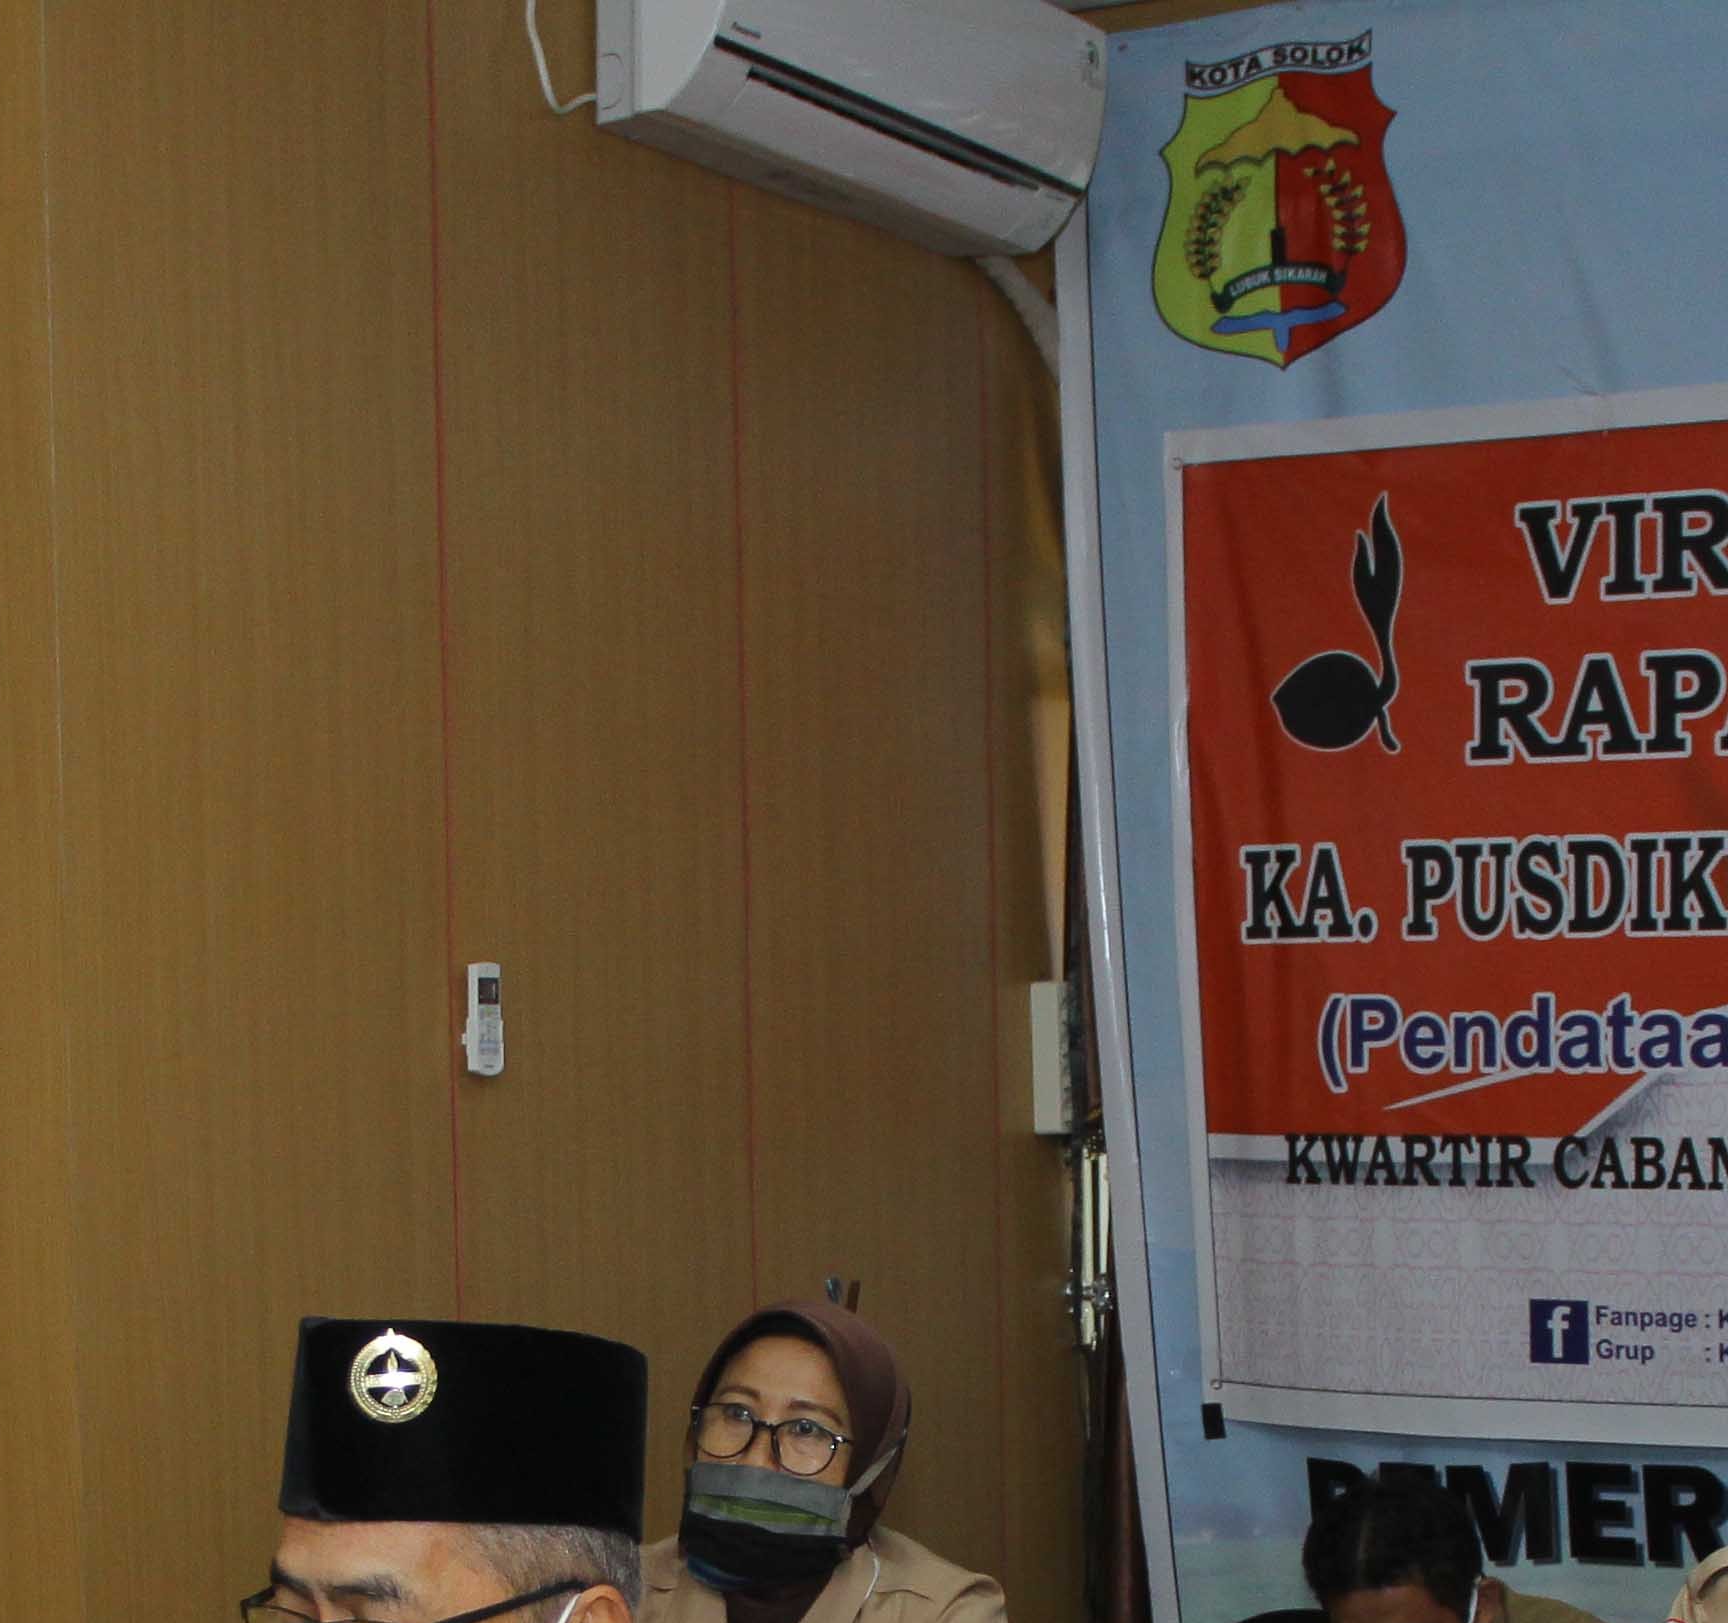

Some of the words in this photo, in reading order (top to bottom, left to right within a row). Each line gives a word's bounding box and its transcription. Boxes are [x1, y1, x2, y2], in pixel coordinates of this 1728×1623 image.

[1189, 56, 1262, 87] KOTA
[1273, 41, 1367, 66] SOLOK
[1240, 841, 1378, 944] KA.
[1284, 1132, 1535, 1188] KWARTIR
[1595, 1305, 1697, 1333] Fanpage
[1596, 1339, 1655, 1365] Grup
